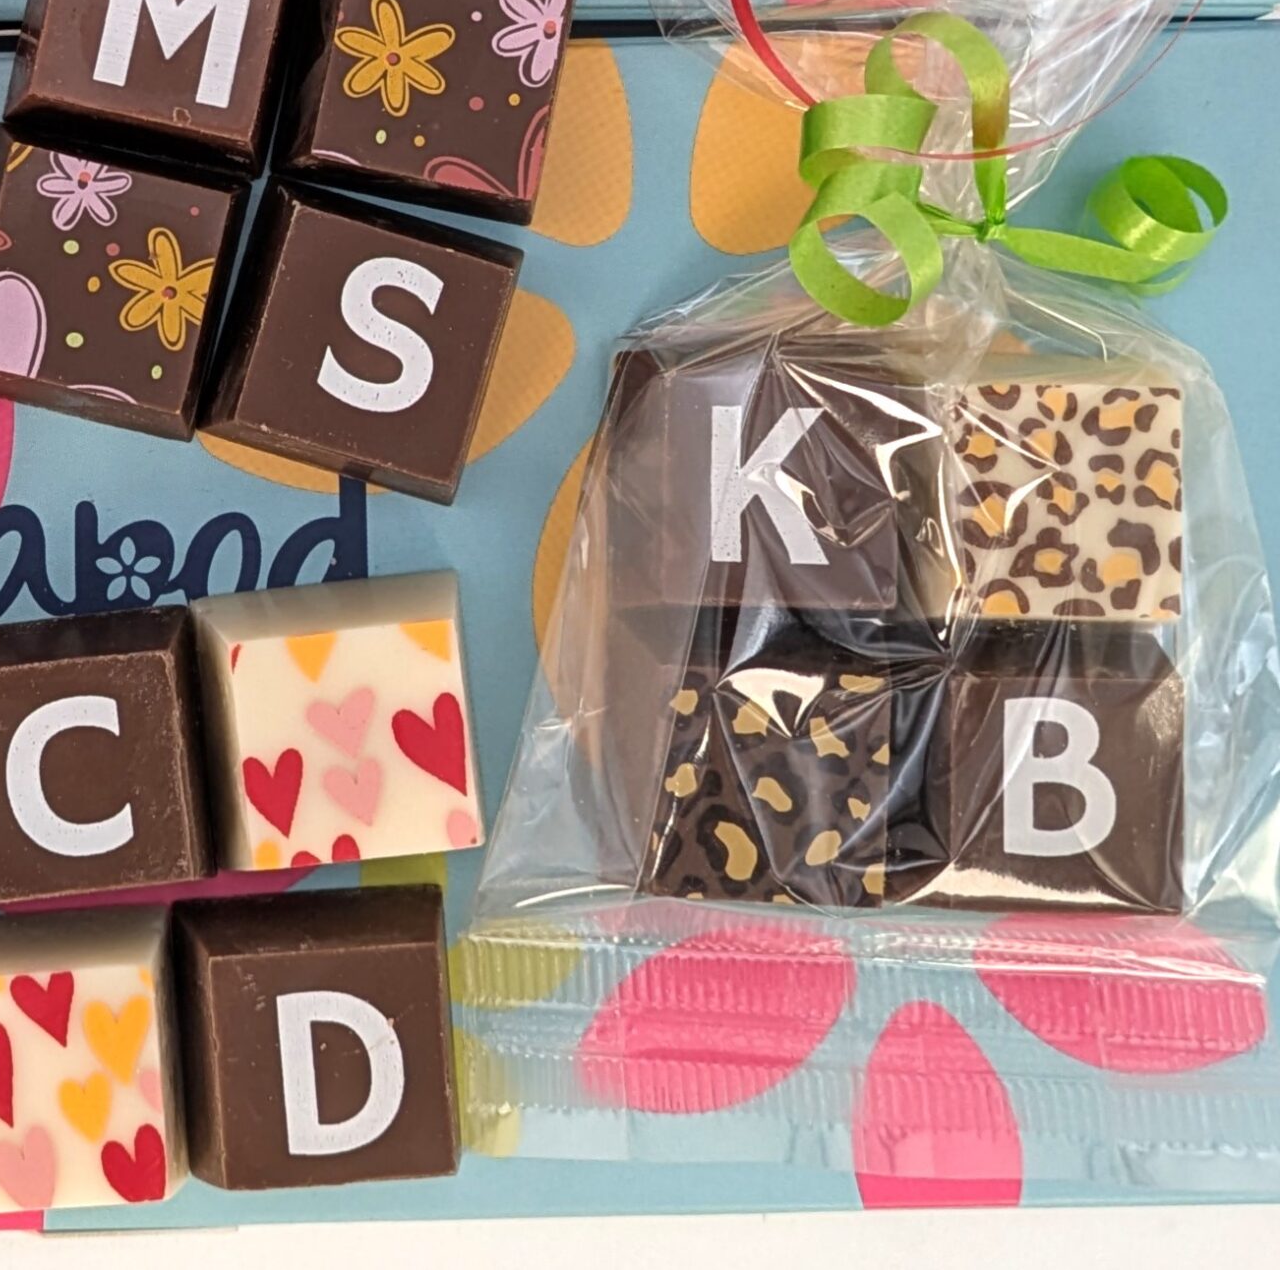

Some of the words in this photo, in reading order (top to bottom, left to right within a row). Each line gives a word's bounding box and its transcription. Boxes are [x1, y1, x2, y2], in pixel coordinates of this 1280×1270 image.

[317, 257, 444, 412] S
[711, 406, 830, 565] K
[6, 695, 134, 856] C
[1003, 697, 1116, 856] B
[276, 990, 404, 1155] D
